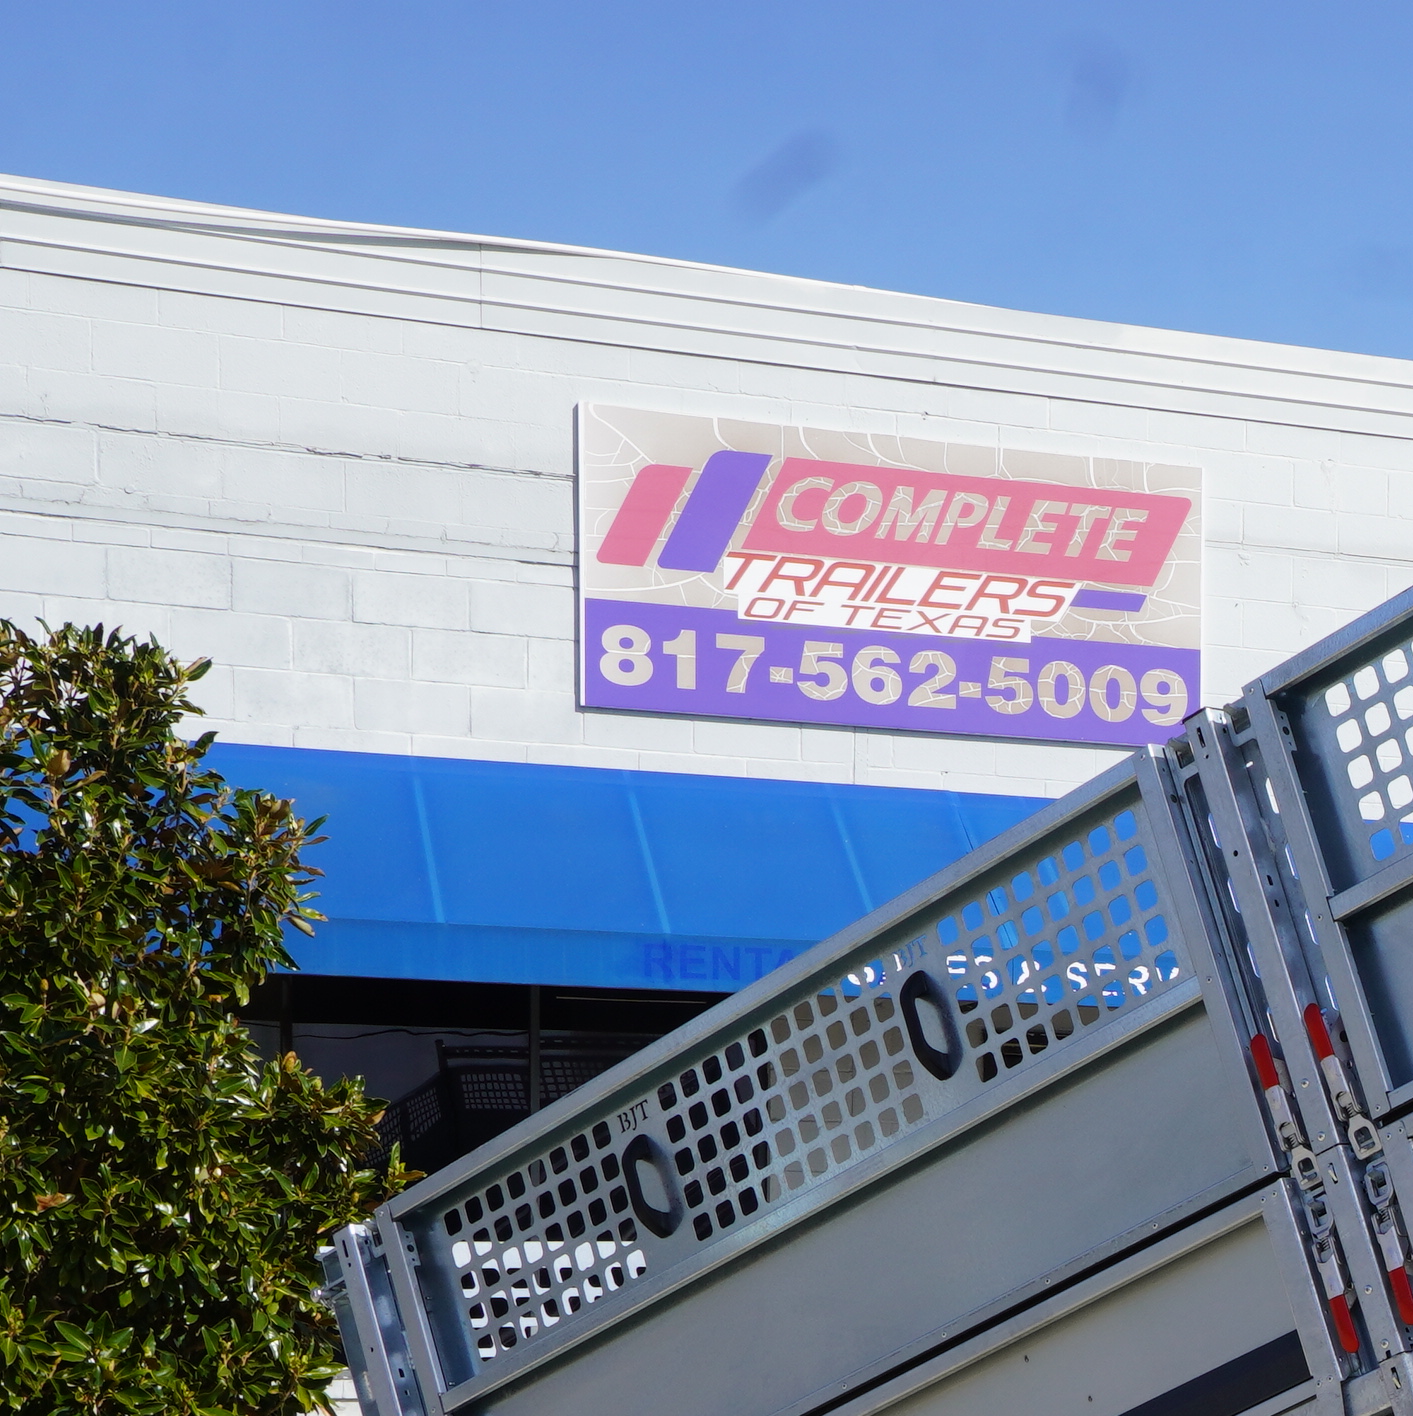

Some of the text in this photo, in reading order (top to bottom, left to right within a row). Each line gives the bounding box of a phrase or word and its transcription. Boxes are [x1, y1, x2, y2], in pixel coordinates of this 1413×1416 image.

[775, 476, 1149, 563] COMPLETE
[724, 551, 1077, 617] TRAILERS
[742, 595, 1026, 639] OF TEXAS
[600, 624, 1189, 727] 817-562-5009
[617, 1100, 650, 1133] BJT
